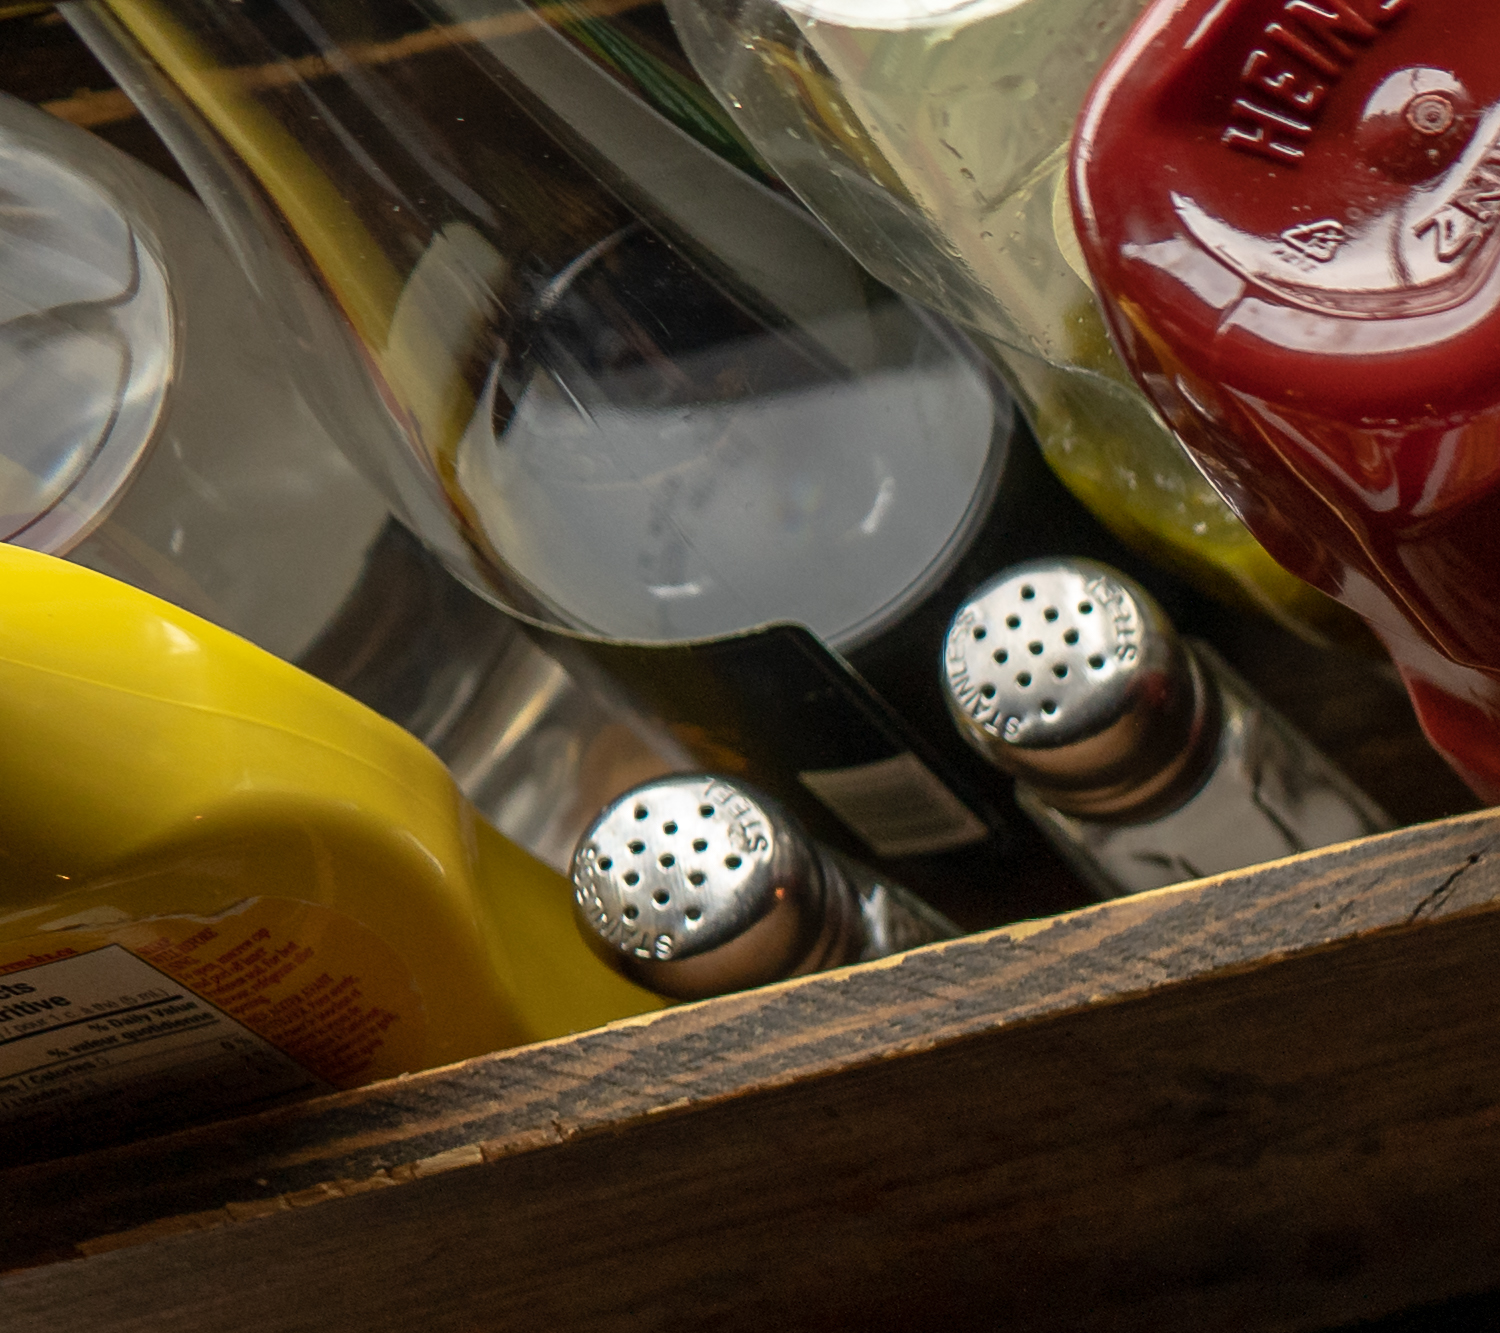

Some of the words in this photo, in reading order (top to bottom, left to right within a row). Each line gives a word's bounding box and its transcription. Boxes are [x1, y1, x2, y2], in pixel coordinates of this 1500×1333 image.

[1220, 0, 1408, 163] HEIN
[703, 775, 770, 854] STEEL
[177, 926, 218, 953] BEFORE
[251, 926, 271, 941] cap
[0, 996, 72, 1021] ritive
[109, 1013, 151, 1029] Daily
[152, 1000, 199, 1018] Value
[69, 1035, 118, 1053] valeur
[121, 1012, 213, 1039] quotidienne
